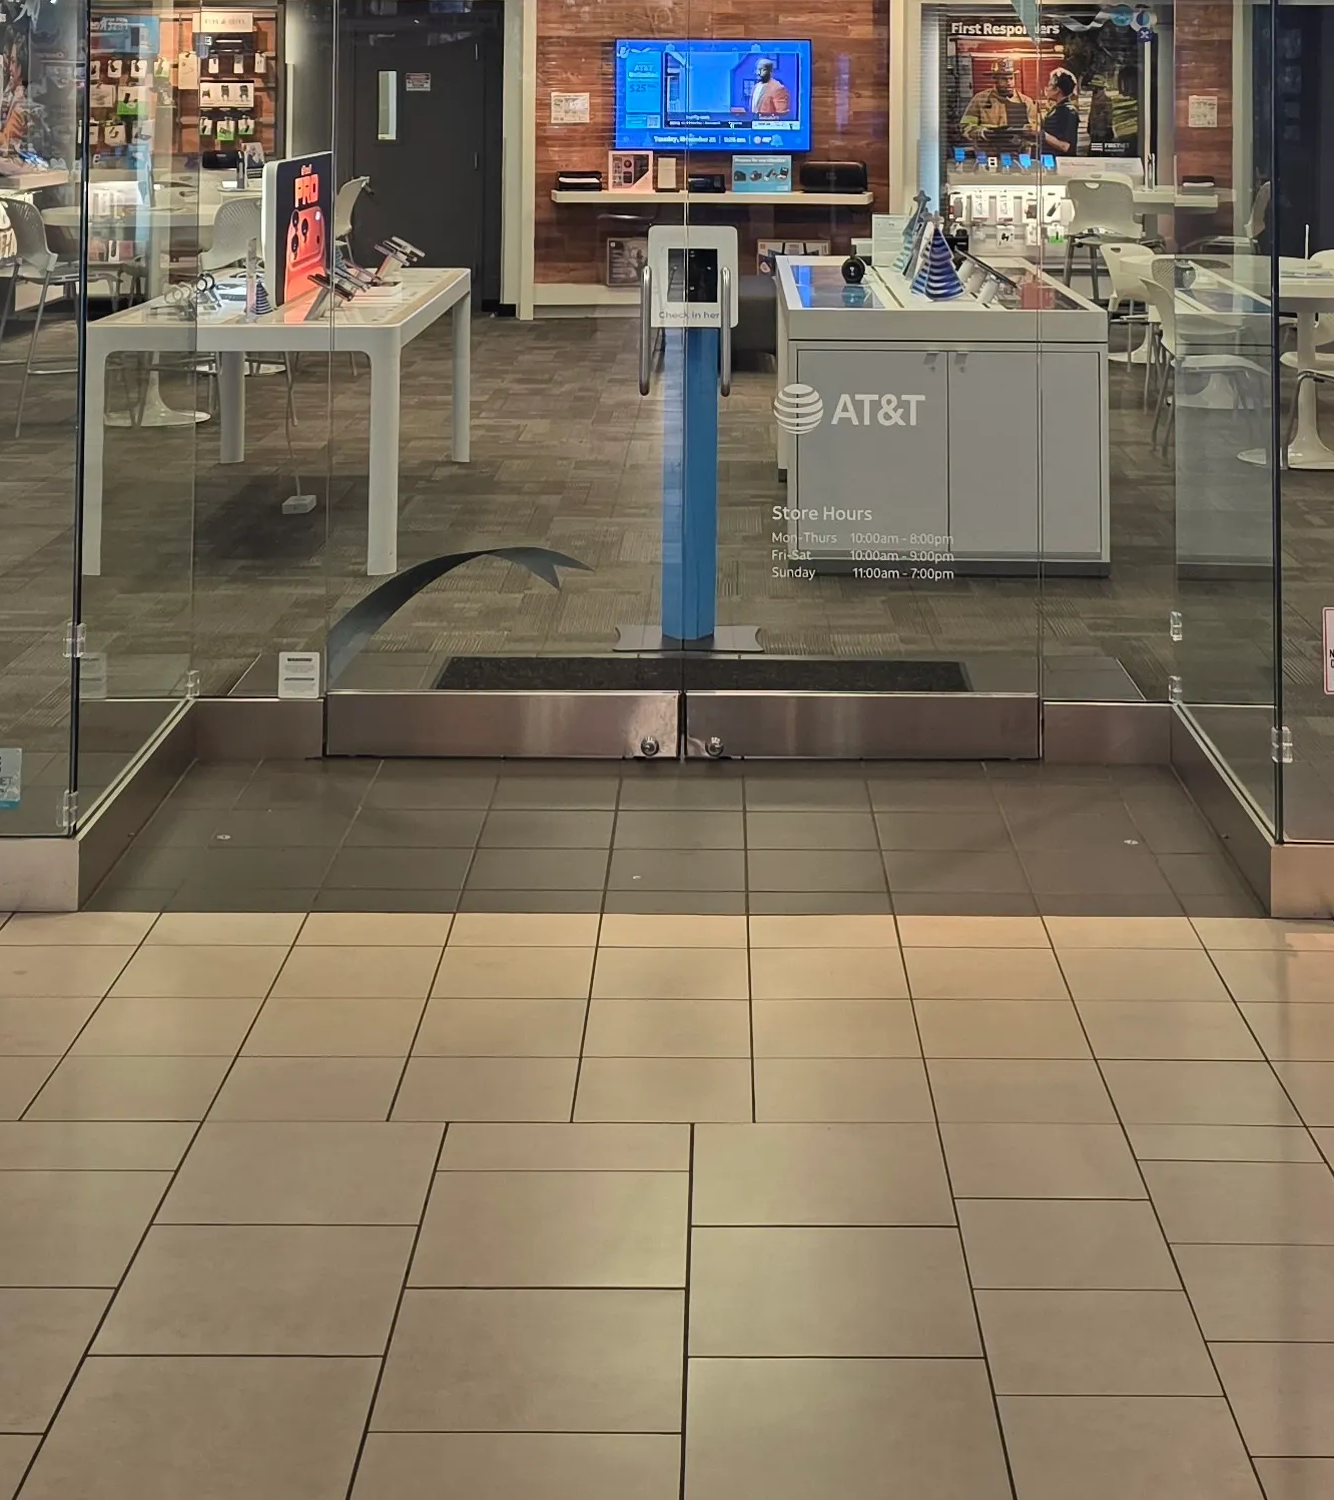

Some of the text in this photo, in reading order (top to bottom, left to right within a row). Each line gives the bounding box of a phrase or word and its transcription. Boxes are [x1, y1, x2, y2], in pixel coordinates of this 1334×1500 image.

[951, 22, 1060, 37] First Respoers
[703, 311, 720, 319] her
[830, 393, 926, 427] AT&T
[771, 505, 873, 521] Store Hours
[771, 531, 837, 544] Mon-Thurs
[850, 533, 898, 544] 10:00am
[909, 533, 954, 547] 8:00pm
[771, 549, 812, 561] Fri-Sat
[850, 550, 899, 562] 10:00am
[909, 550, 955, 565] 9:00pm
[771, 566, 816, 580] Sunday
[853, 567, 900, 579] 11:00am
[911, 567, 954, 581] 7:00pm
